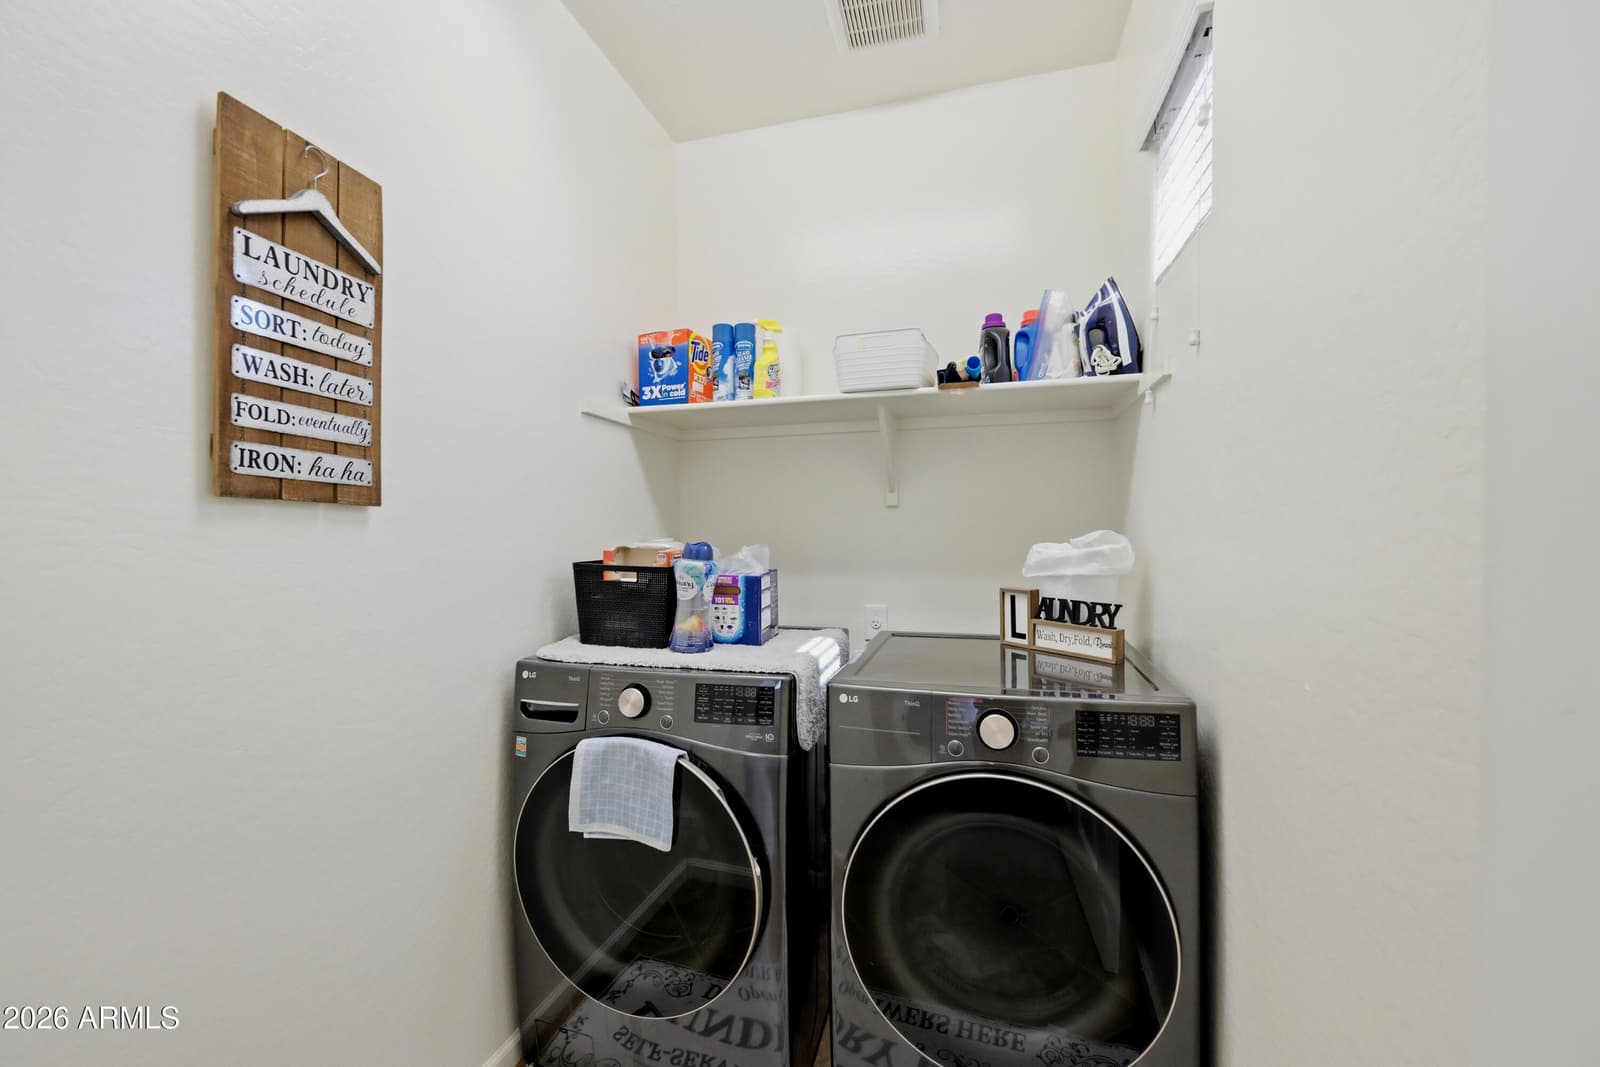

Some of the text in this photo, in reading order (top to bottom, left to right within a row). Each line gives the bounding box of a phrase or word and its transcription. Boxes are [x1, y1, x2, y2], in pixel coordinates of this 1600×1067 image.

[242, 233, 371, 303] LAUNDRY
[257, 270, 358, 319] schedule
[240, 304, 365, 361] SORT: today
[691, 341, 709, 363] Tide
[241, 353, 368, 402] WASH: later
[642, 383, 685, 400] 3X Power
[662, 388, 686, 398] in cold
[235, 400, 368, 443] FOLD: eventually
[238, 447, 368, 483] IRON: ha ha
[1036, 628, 1058, 645] Wash,
[528, 671, 537, 679] LG
[848, 695, 859, 703] LG
